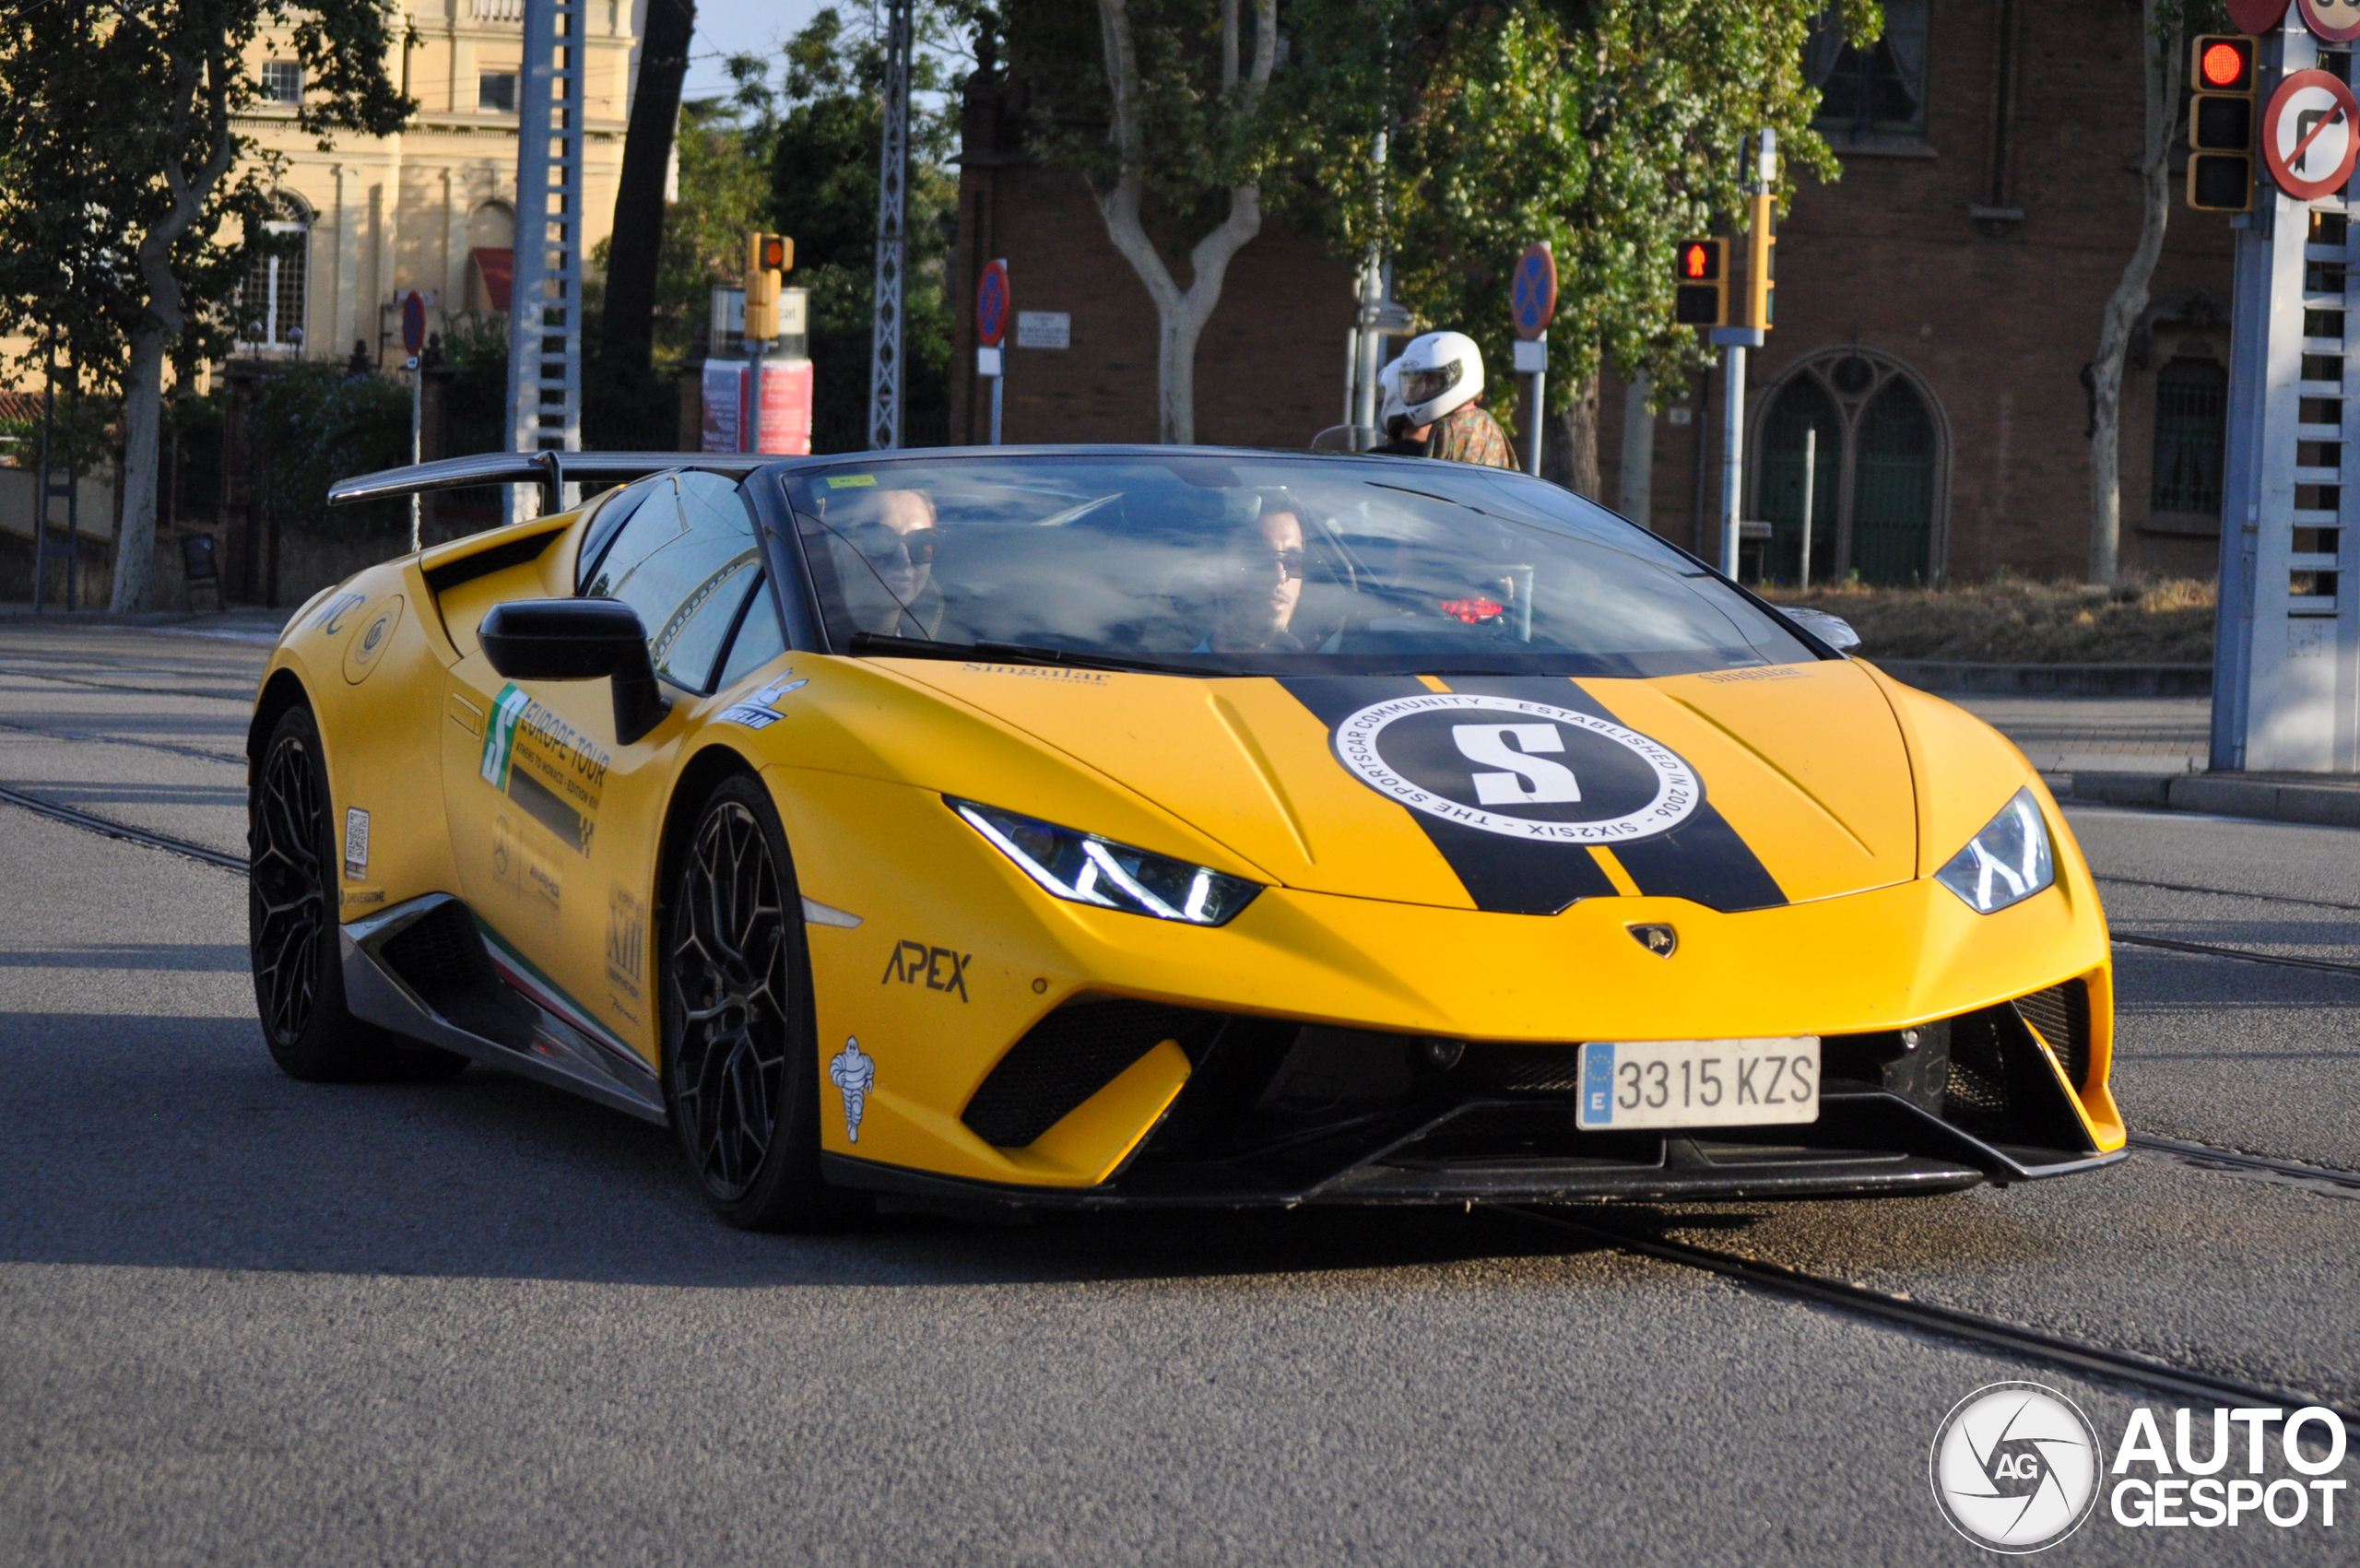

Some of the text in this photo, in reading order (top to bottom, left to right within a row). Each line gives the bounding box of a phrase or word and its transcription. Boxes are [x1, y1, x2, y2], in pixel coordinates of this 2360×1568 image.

[962, 663, 1111, 681] Singular
[520, 701, 610, 789] EUROPE TOUR
[1347, 697, 1689, 838] THE SPORTSCAR COMMUNITY ESTABLISHED IN 2006 SIX2SIX
[1452, 724, 1581, 805] S
[881, 939, 974, 1003] APEX
[1591, 1092, 1606, 1110] E
[1618, 1055, 1813, 1110] 3315 KZS
